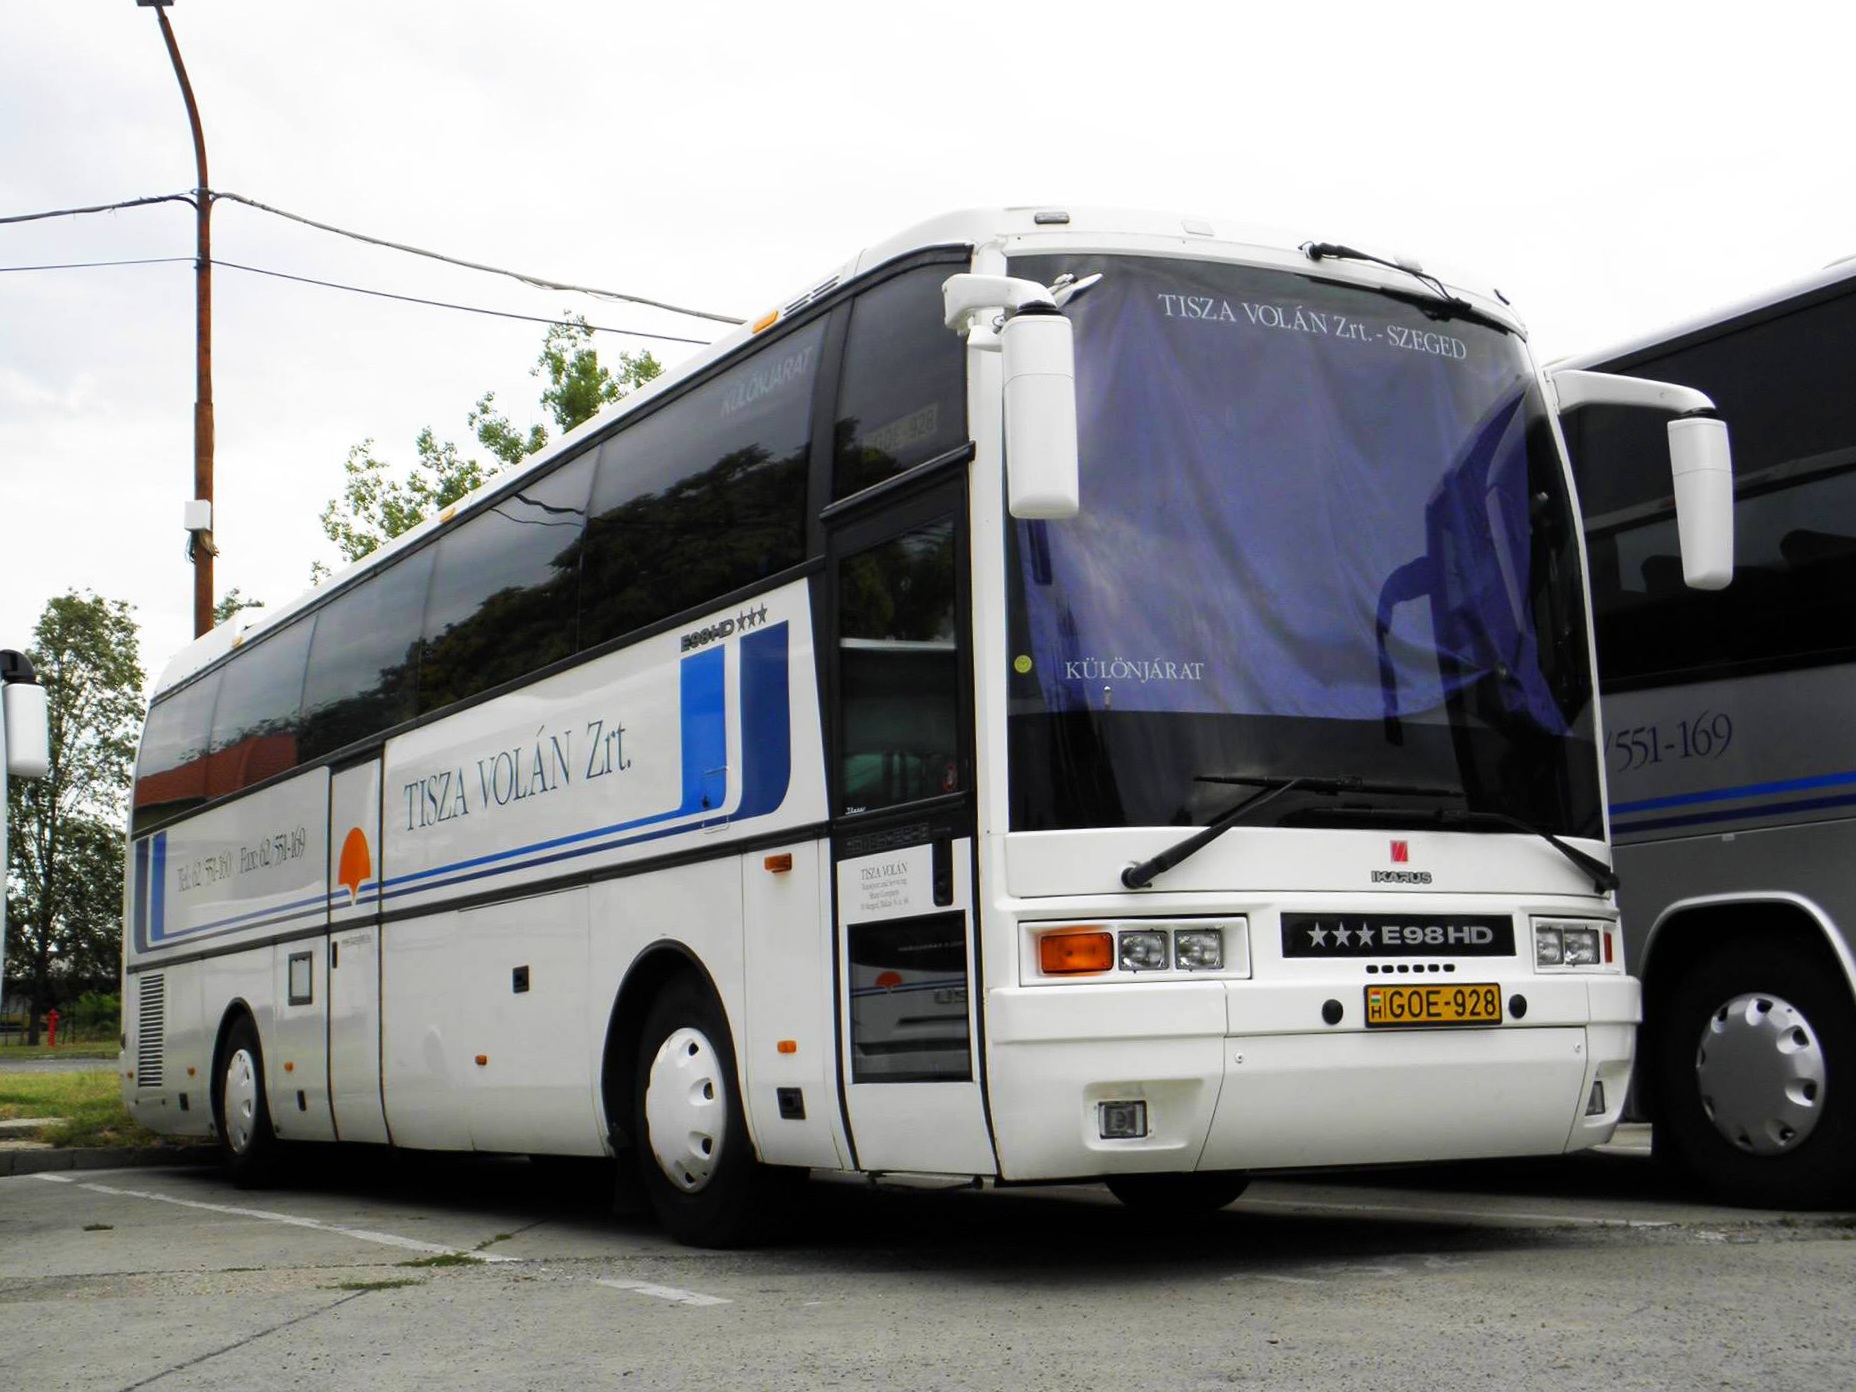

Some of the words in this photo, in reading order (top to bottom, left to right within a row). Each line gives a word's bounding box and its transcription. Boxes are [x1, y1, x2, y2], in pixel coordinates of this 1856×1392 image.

[1158, 294, 1237, 322] TISZA
[1242, 302, 1328, 334] VOLÁN
[1333, 315, 1373, 342] Zrt.
[1386, 324, 1467, 360] SZEGED
[680, 618, 735, 653] E98HD
[1065, 656, 1204, 684] KÜLÖNJÁRAT
[403, 766, 469, 831] TISZA
[477, 724, 572, 811] VOLÁN
[585, 719, 632, 780] Zrt.
[1371, 870, 1432, 884] IKARUS
[1371, 1004, 1382, 1019] H
[1389, 988, 1497, 1019] GOE-928
